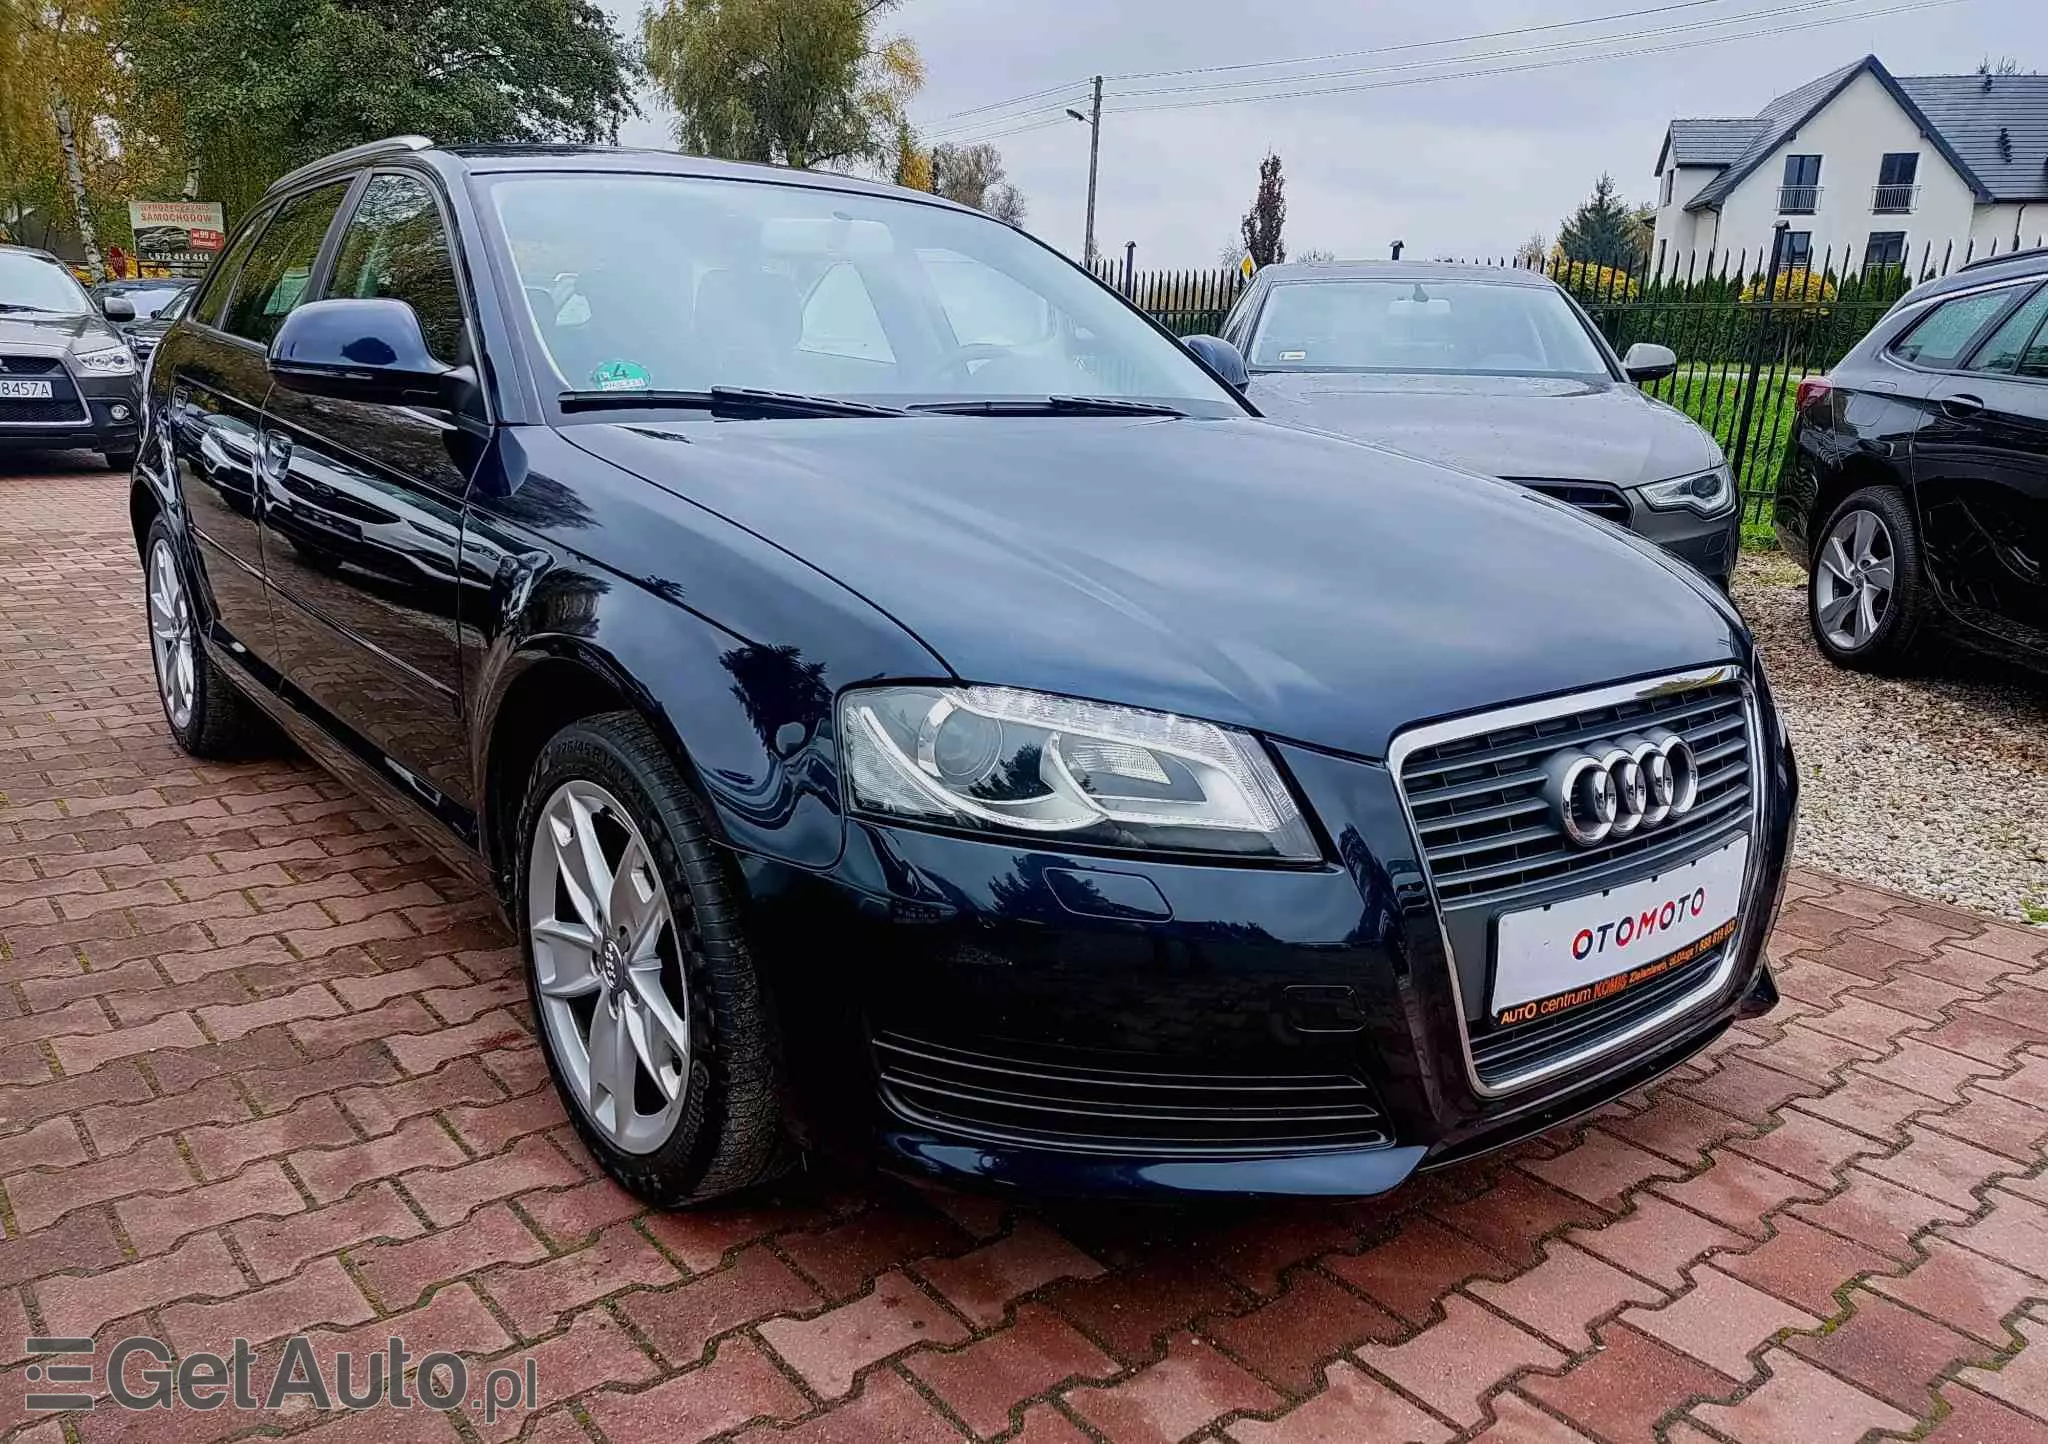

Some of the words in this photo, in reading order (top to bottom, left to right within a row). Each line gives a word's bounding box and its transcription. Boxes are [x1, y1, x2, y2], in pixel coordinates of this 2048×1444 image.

[155, 252, 171, 260] 572
[1, 382, 50, 396] 8457A
[1572, 887, 1705, 960] OTOMOTO
[1501, 1002, 1537, 1025] AUTO
[1541, 988, 1592, 1013] centrum
